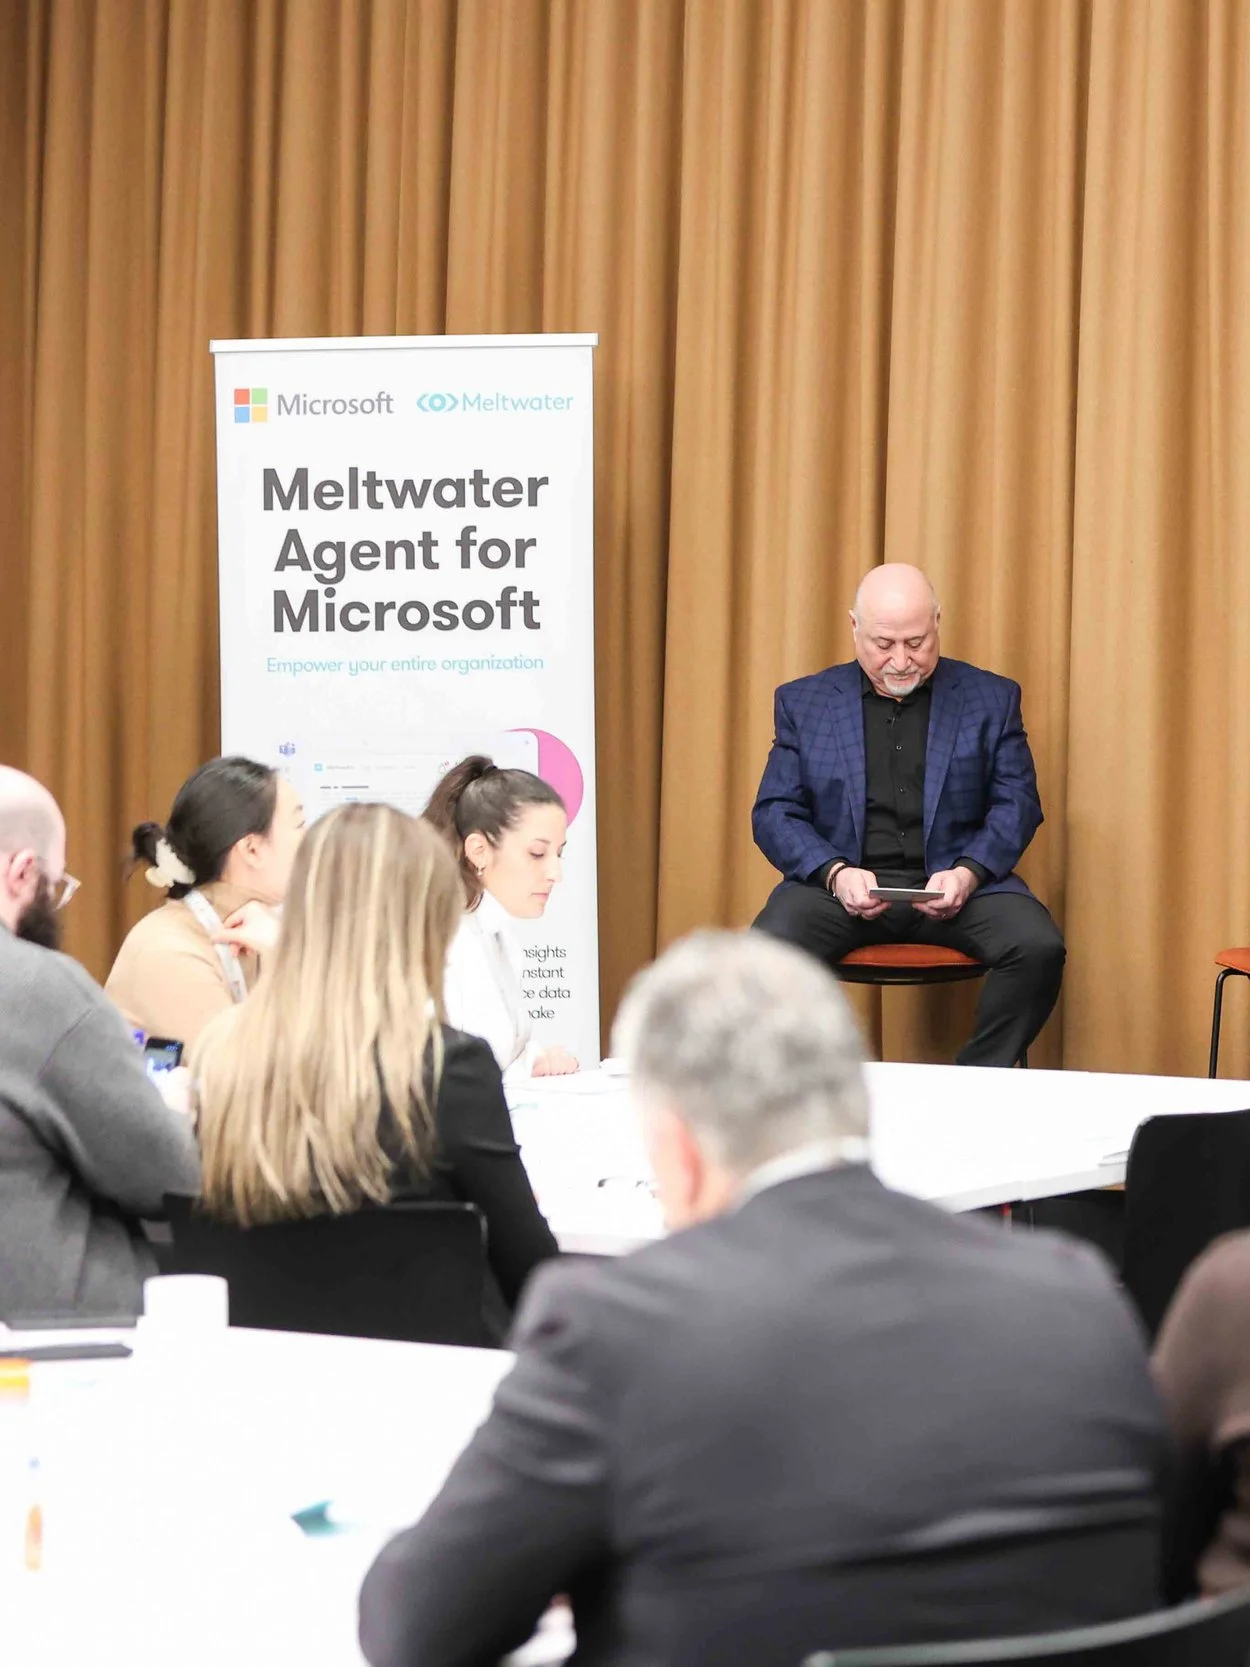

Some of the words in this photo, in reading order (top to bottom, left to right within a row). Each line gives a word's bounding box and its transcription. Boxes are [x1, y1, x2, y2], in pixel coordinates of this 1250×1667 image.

[277, 391, 394, 416] Microsoft
[463, 392, 574, 412] Meltwater
[263, 467, 549, 511] Meltwater
[274, 528, 439, 585] Agent
[456, 525, 536, 569] for
[273, 586, 540, 632] Microsoft
[267, 657, 343, 676] Empower
[348, 659, 387, 676] your
[391, 655, 437, 671] entire
[441, 653, 544, 675] organization
[522, 945, 567, 963] nsights
[522, 966, 565, 978] nstant
[538, 985, 571, 999] data
